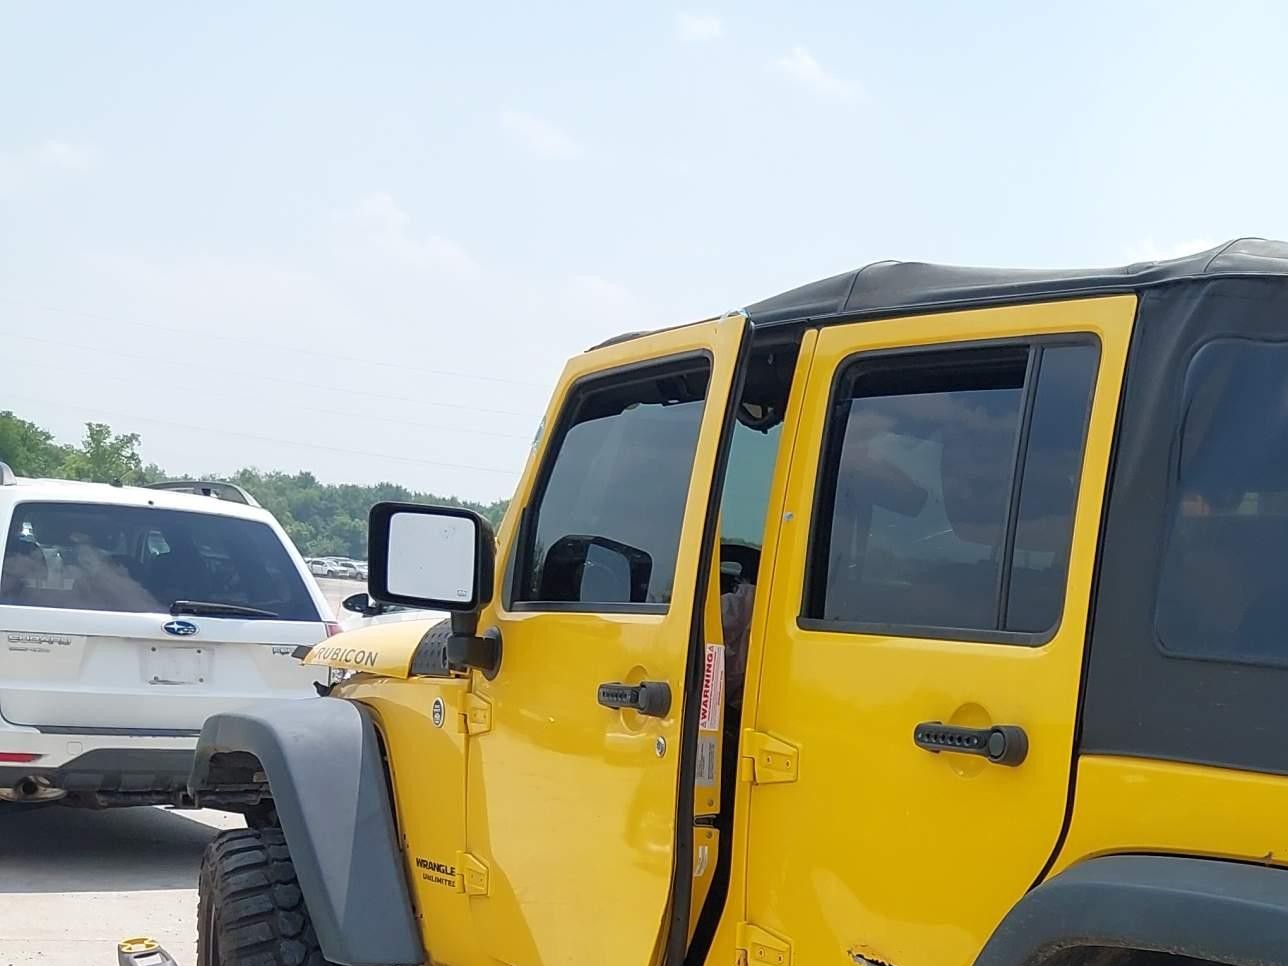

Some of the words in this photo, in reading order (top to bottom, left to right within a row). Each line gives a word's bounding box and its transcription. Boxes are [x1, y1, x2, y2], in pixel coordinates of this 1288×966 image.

[317, 647, 379, 667] RUBICON
[701, 653, 714, 720] WARNING
[416, 857, 456, 877] WRANGLE
